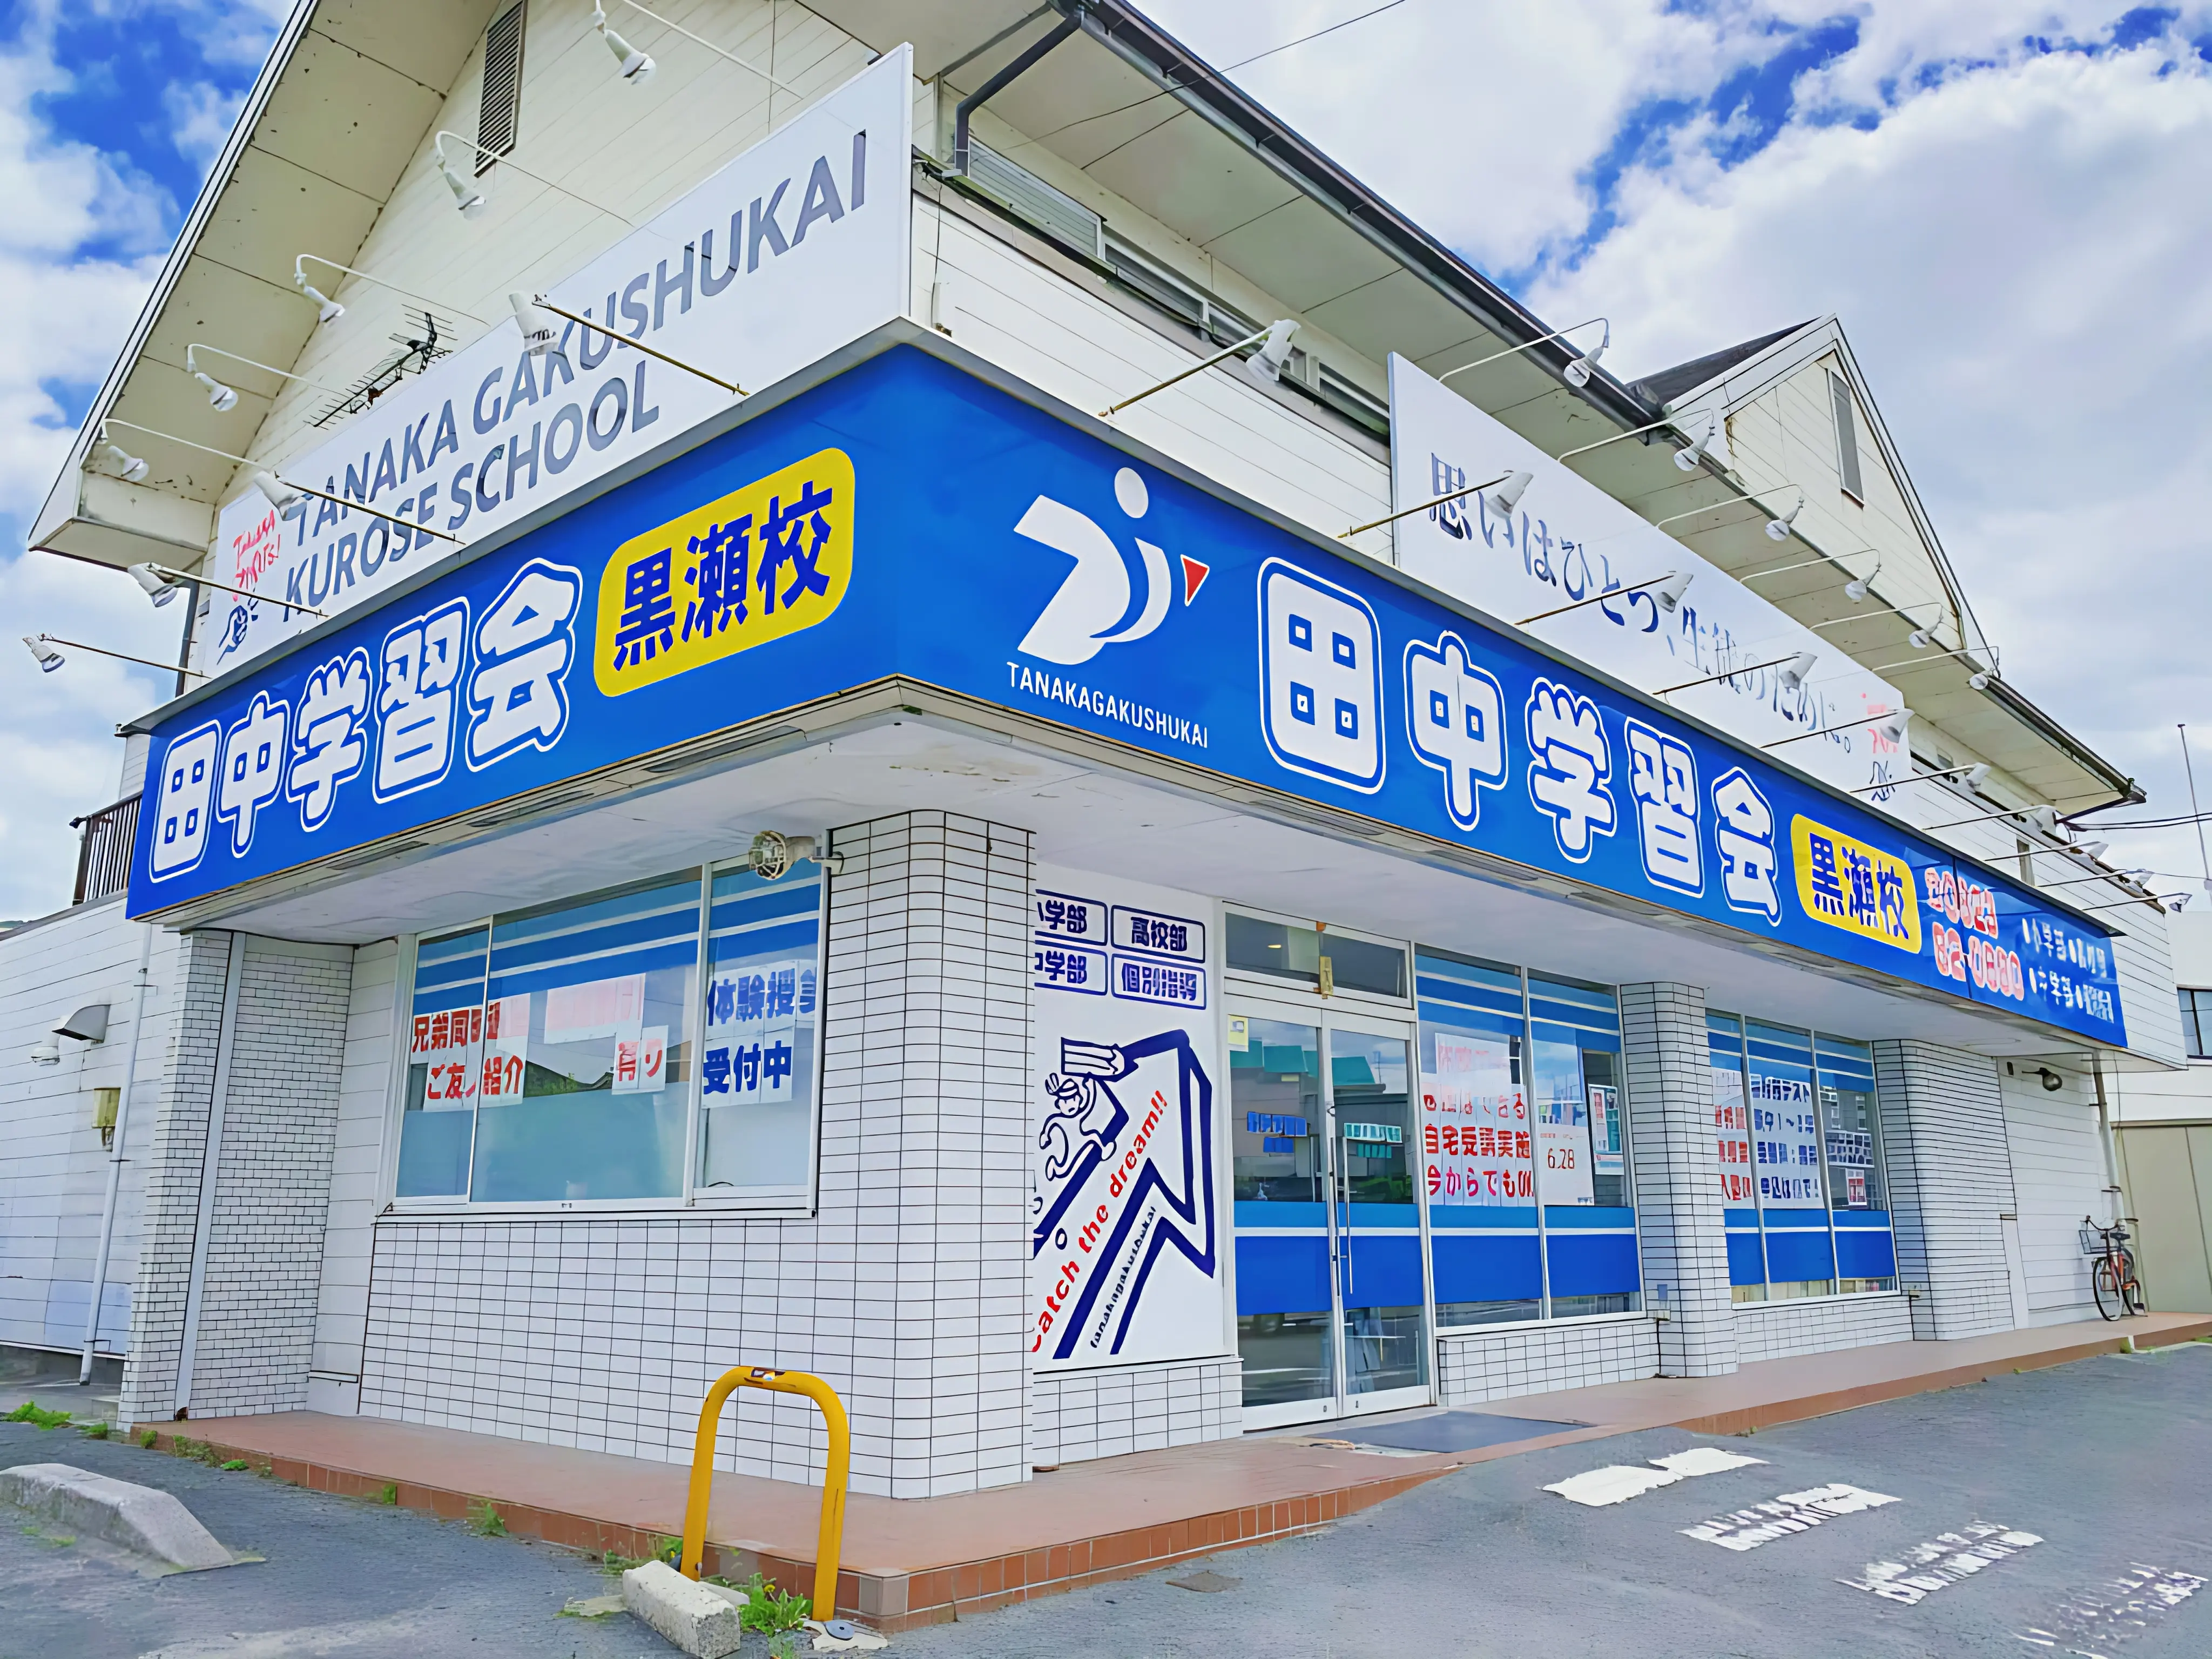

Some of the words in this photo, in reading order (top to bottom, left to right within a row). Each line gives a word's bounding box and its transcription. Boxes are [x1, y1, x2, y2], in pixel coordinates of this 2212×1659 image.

[296, 400, 458, 546] TANAKA
[473, 129, 866, 435] GAKUSHUKAI
[283, 483, 438, 623] KUROSE
[448, 360, 659, 530] SCHOOL
[150, 557, 583, 884] 田中学習会
[613, 481, 833, 671] 黒瀬校
[1006, 662, 1209, 748] TANAKAGAKUSHUKAI
[1258, 557, 1782, 927] 田中学習会
[1809, 832, 1910, 940] 黒瀬校
[1131, 916, 1187, 952] 高校部
[703, 1040, 792, 1095] 受付中
[1078, 1205, 1109, 1253] the
[1109, 1090, 1168, 1198] dream!!
